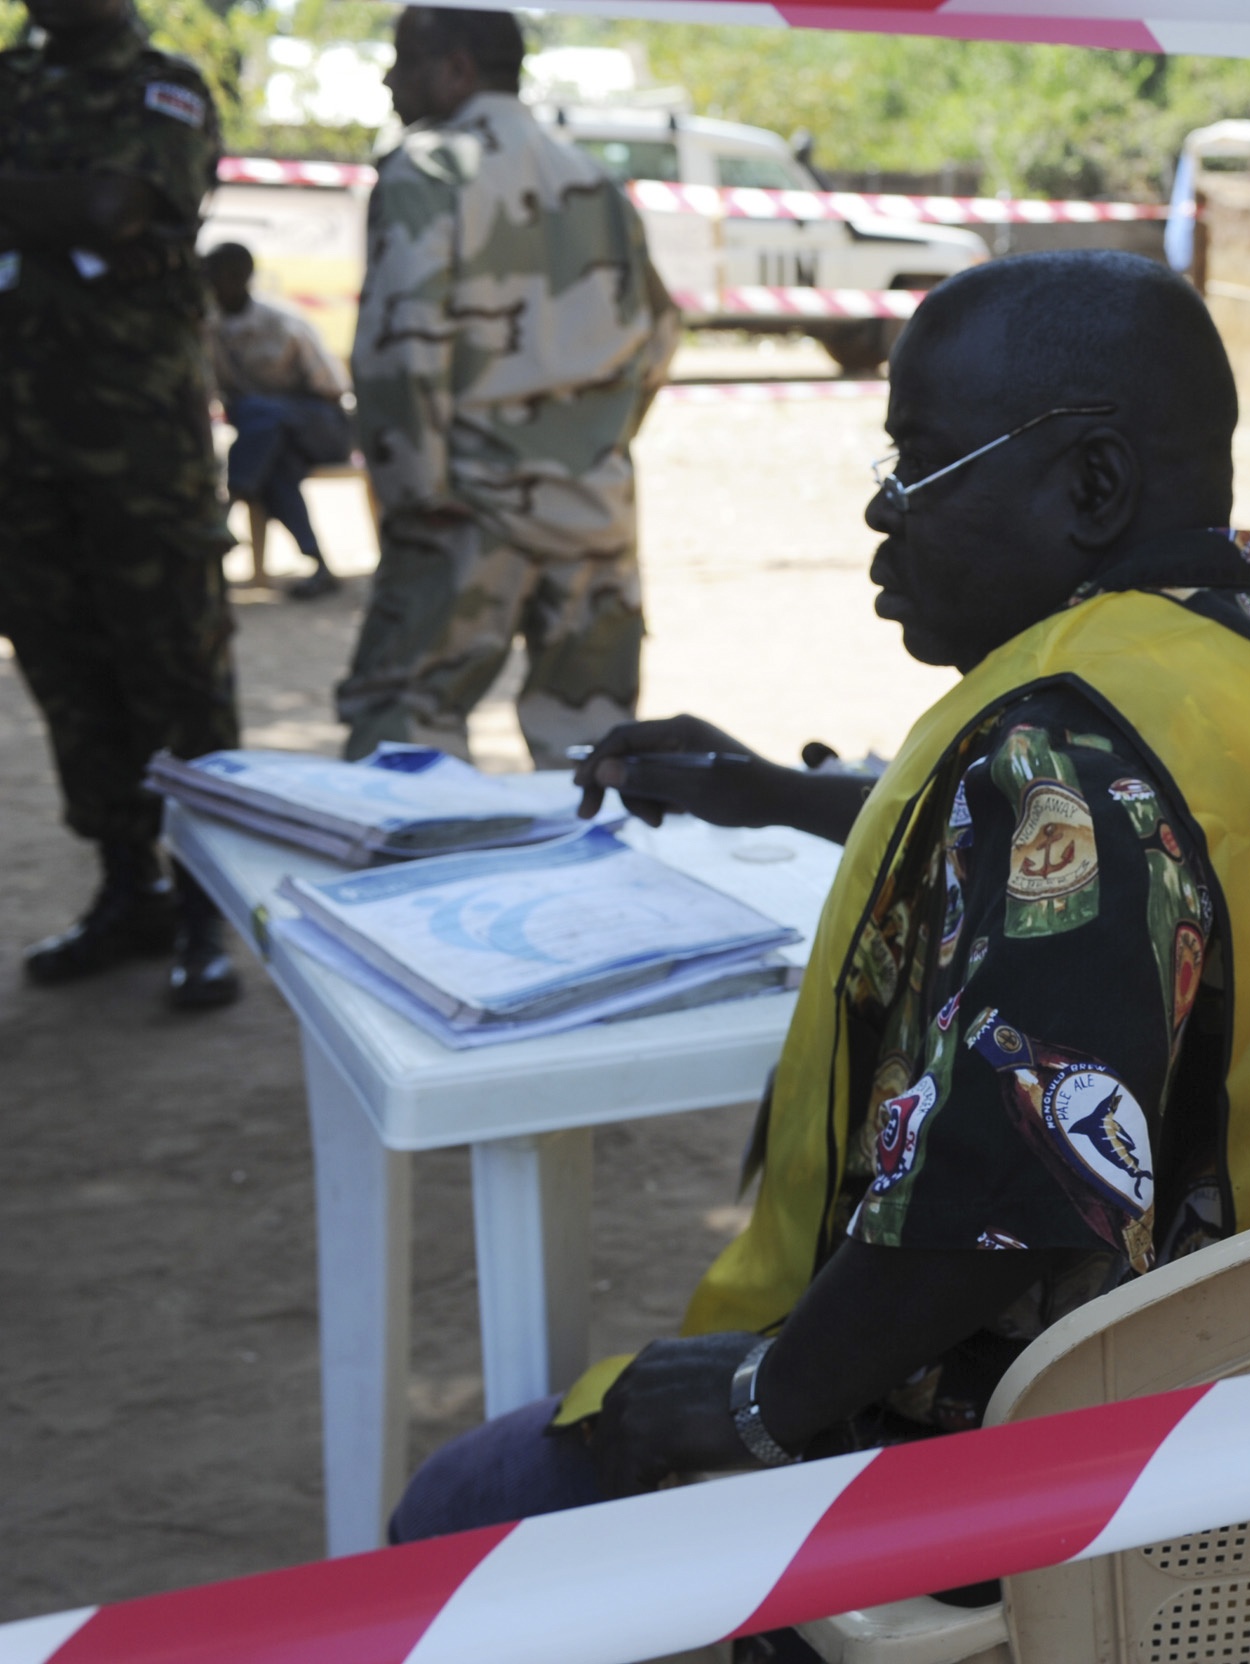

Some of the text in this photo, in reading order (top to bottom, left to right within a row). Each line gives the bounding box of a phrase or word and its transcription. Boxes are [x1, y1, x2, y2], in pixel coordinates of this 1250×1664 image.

[1043, 797, 1078, 818] AWAY
[1070, 1063, 1106, 1072] BREW
[1056, 1073, 1095, 1121] PALE ALE
